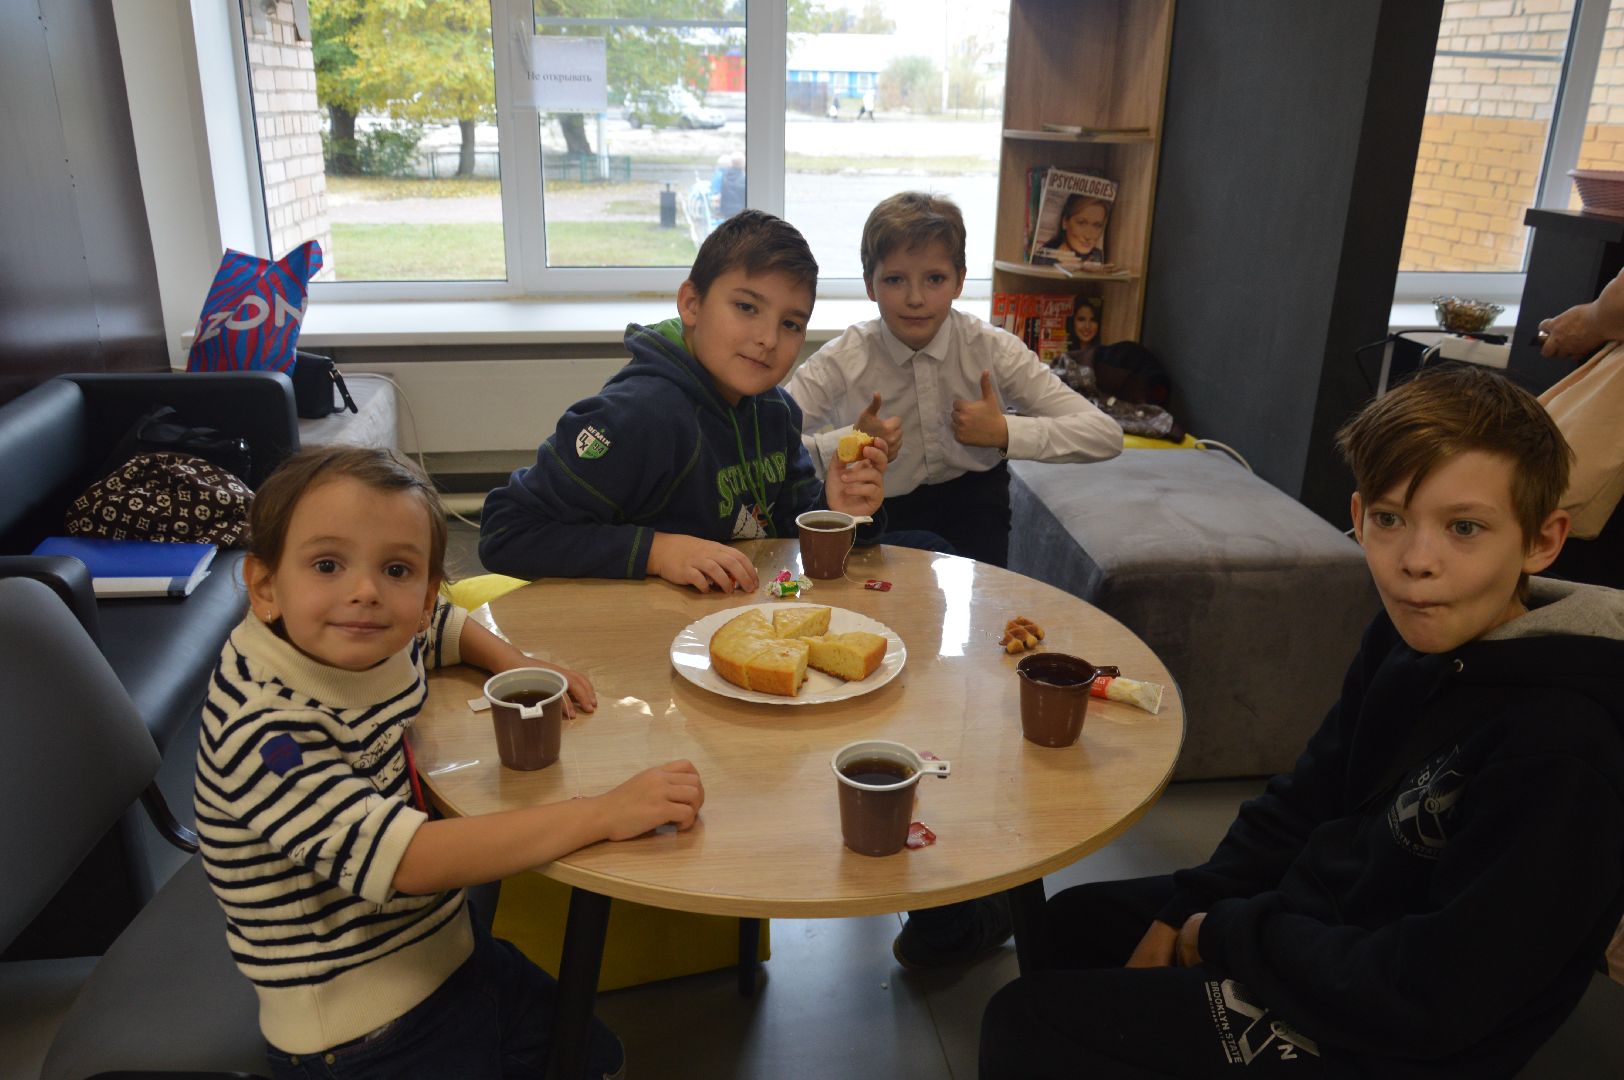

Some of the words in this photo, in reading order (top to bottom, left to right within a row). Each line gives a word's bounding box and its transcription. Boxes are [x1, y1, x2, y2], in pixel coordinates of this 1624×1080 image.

[527, 71, 540, 81] Не
[542, 73, 592, 83] открывать
[1051, 174, 1115, 199] PSYCHOLOGIES
[193, 293, 308, 345] ZON
[1210, 981, 1230, 1031] BROOKLYN
[1225, 1033, 1243, 1064] STATE
